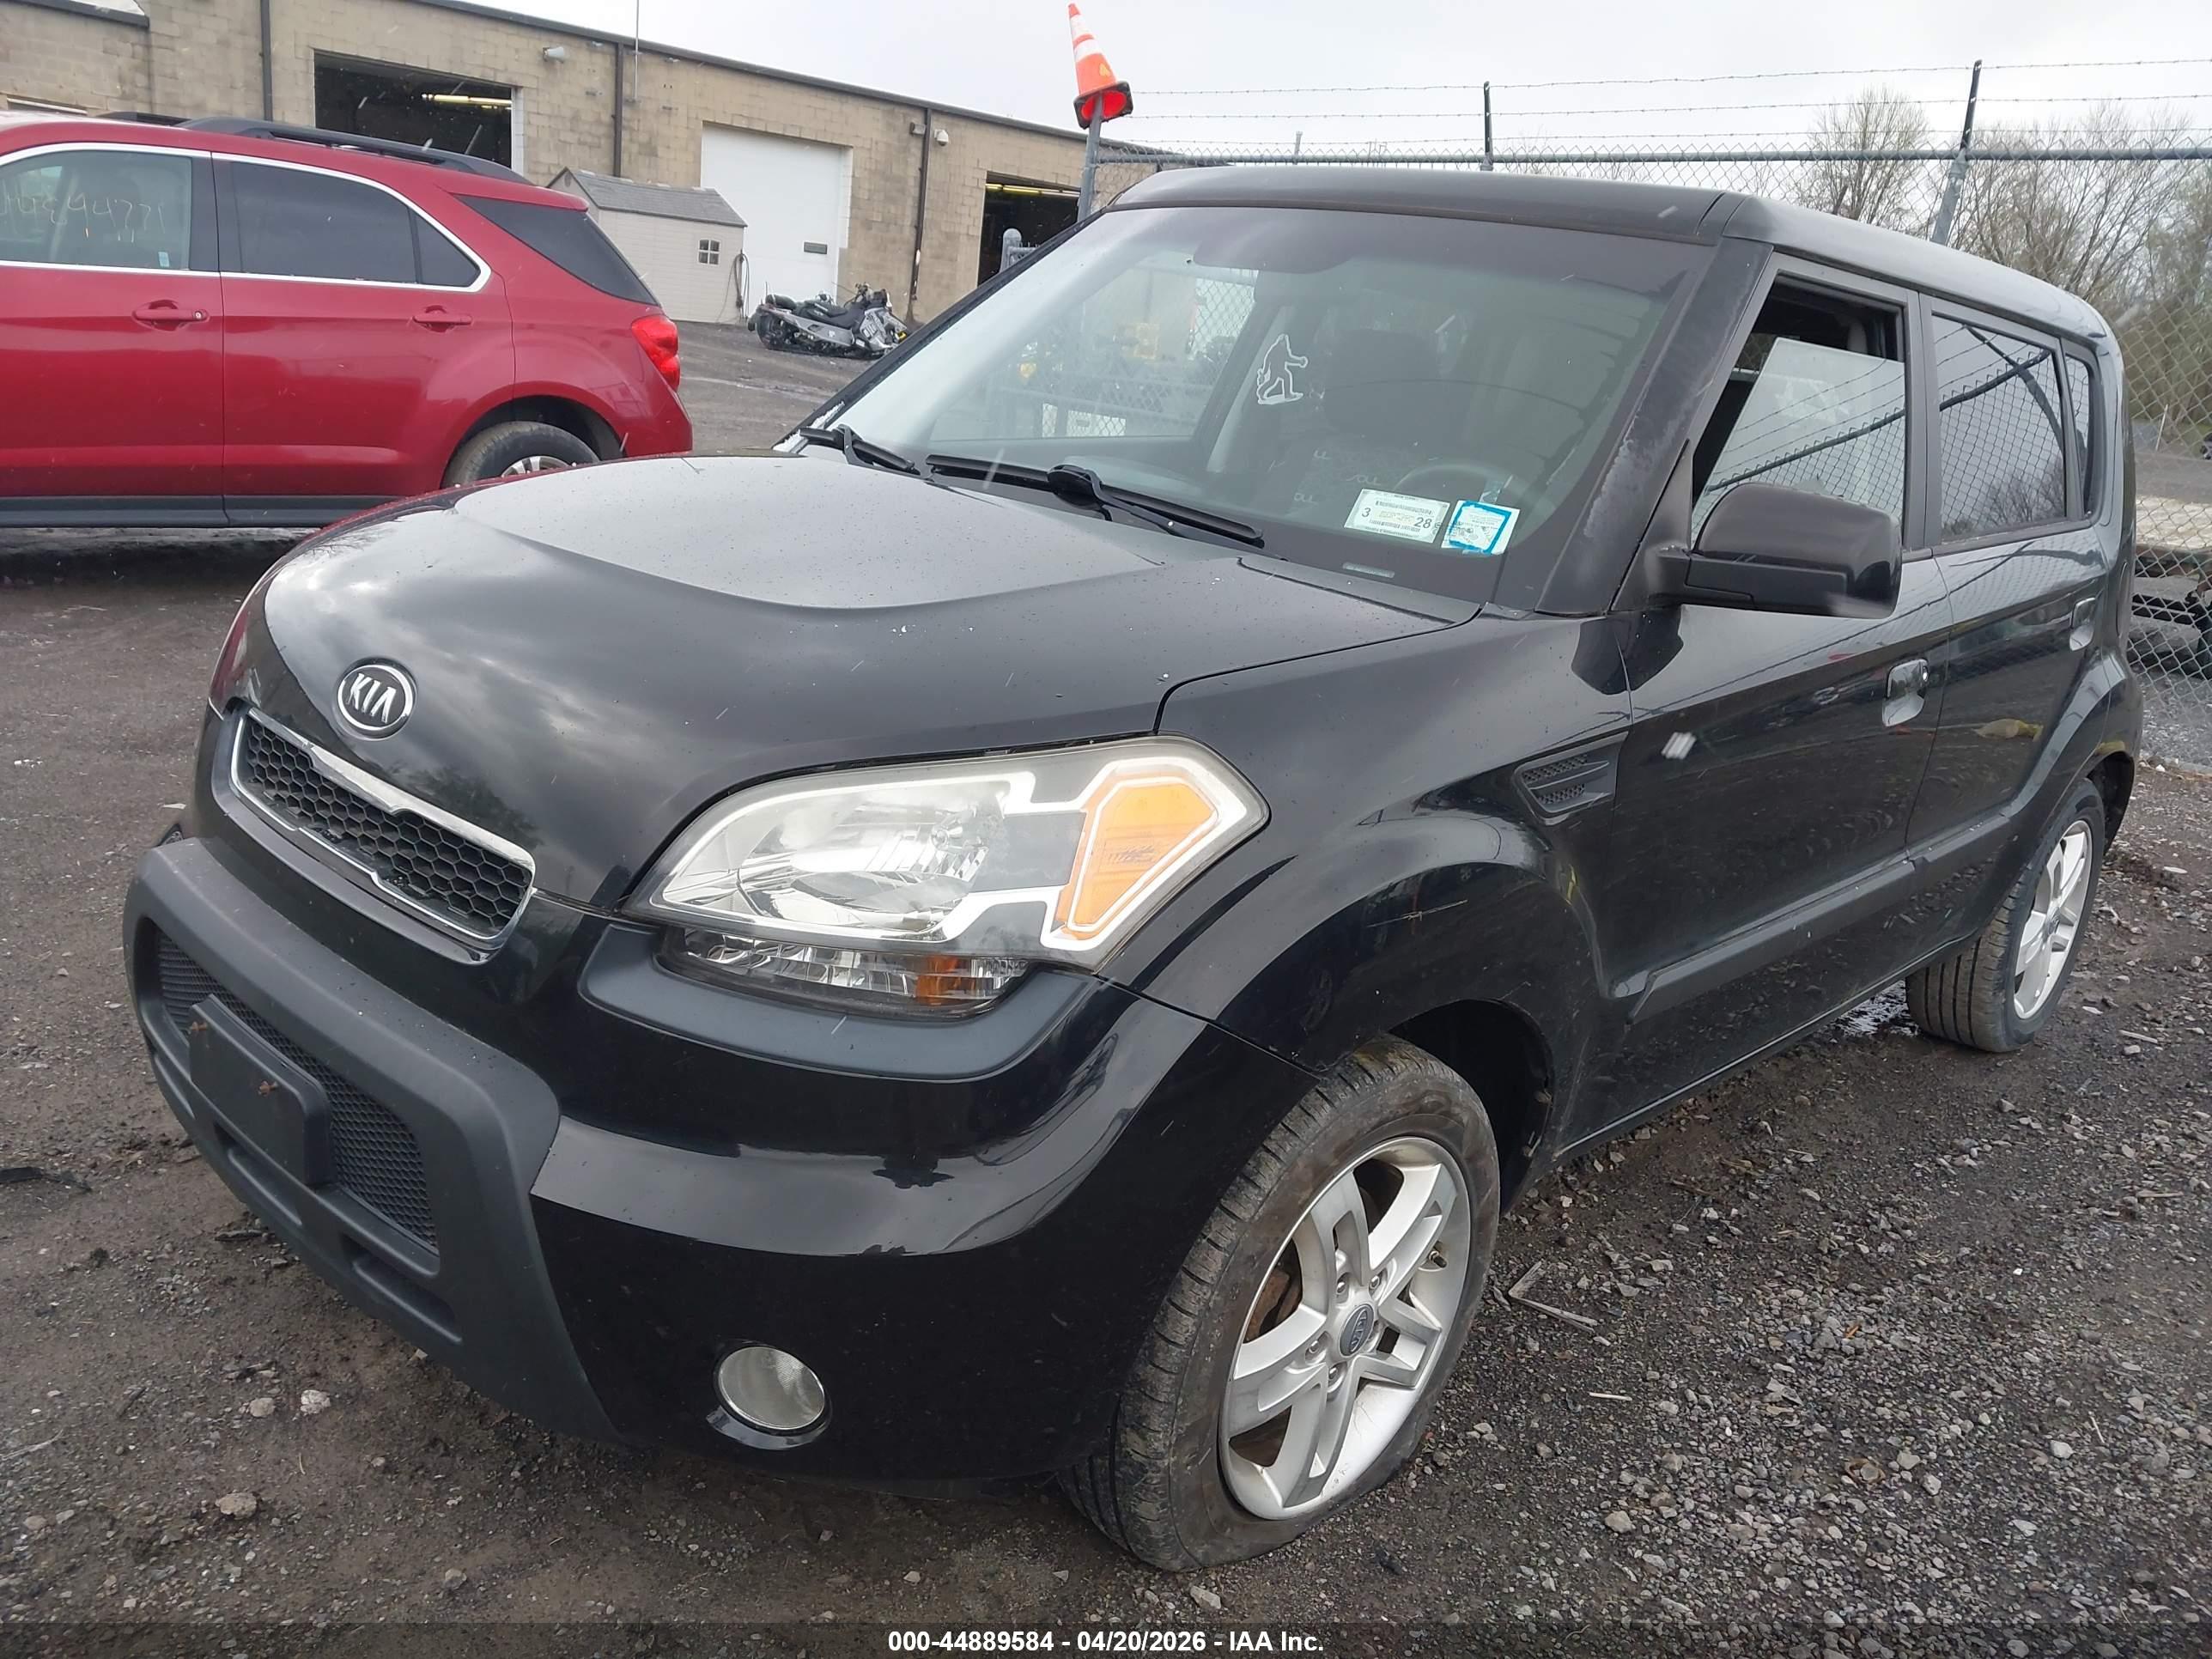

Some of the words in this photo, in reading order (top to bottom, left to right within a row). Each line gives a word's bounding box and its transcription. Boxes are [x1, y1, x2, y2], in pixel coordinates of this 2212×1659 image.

[1361, 507, 1371, 518] 3
[1413, 516, 1432, 529] 28
[346, 672, 397, 724] KIA
